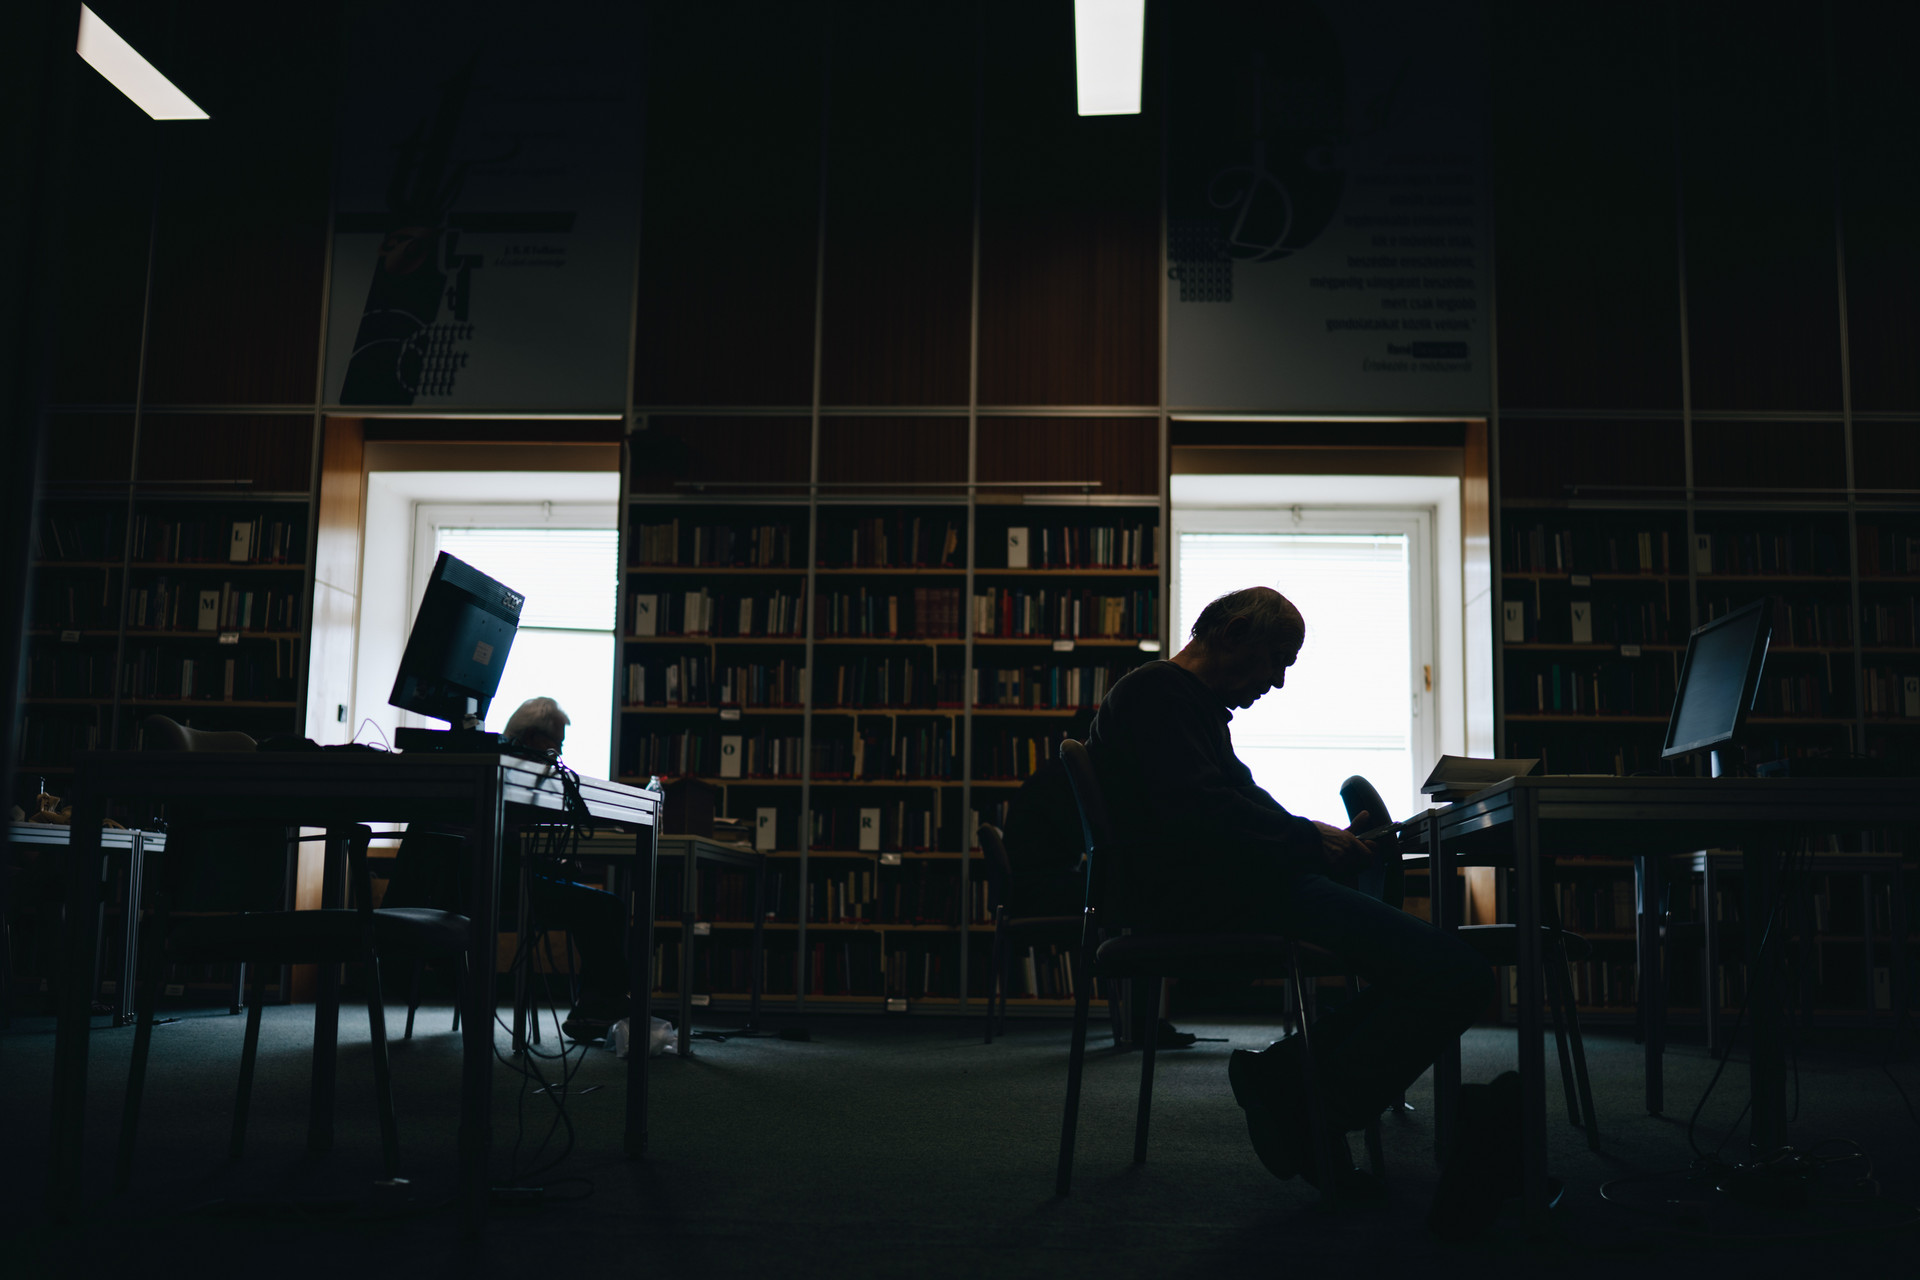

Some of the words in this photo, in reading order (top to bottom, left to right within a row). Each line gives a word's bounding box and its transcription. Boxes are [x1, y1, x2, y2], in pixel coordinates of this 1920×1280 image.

[234, 530, 243, 542] L
[1010, 536, 1019, 547] S
[202, 598, 215, 610] M
[639, 602, 651, 615] N
[1506, 609, 1516, 621] U
[1574, 609, 1584, 621] V
[723, 744, 735, 756] O
[759, 816, 769, 829] P
[862, 816, 873, 829] R
